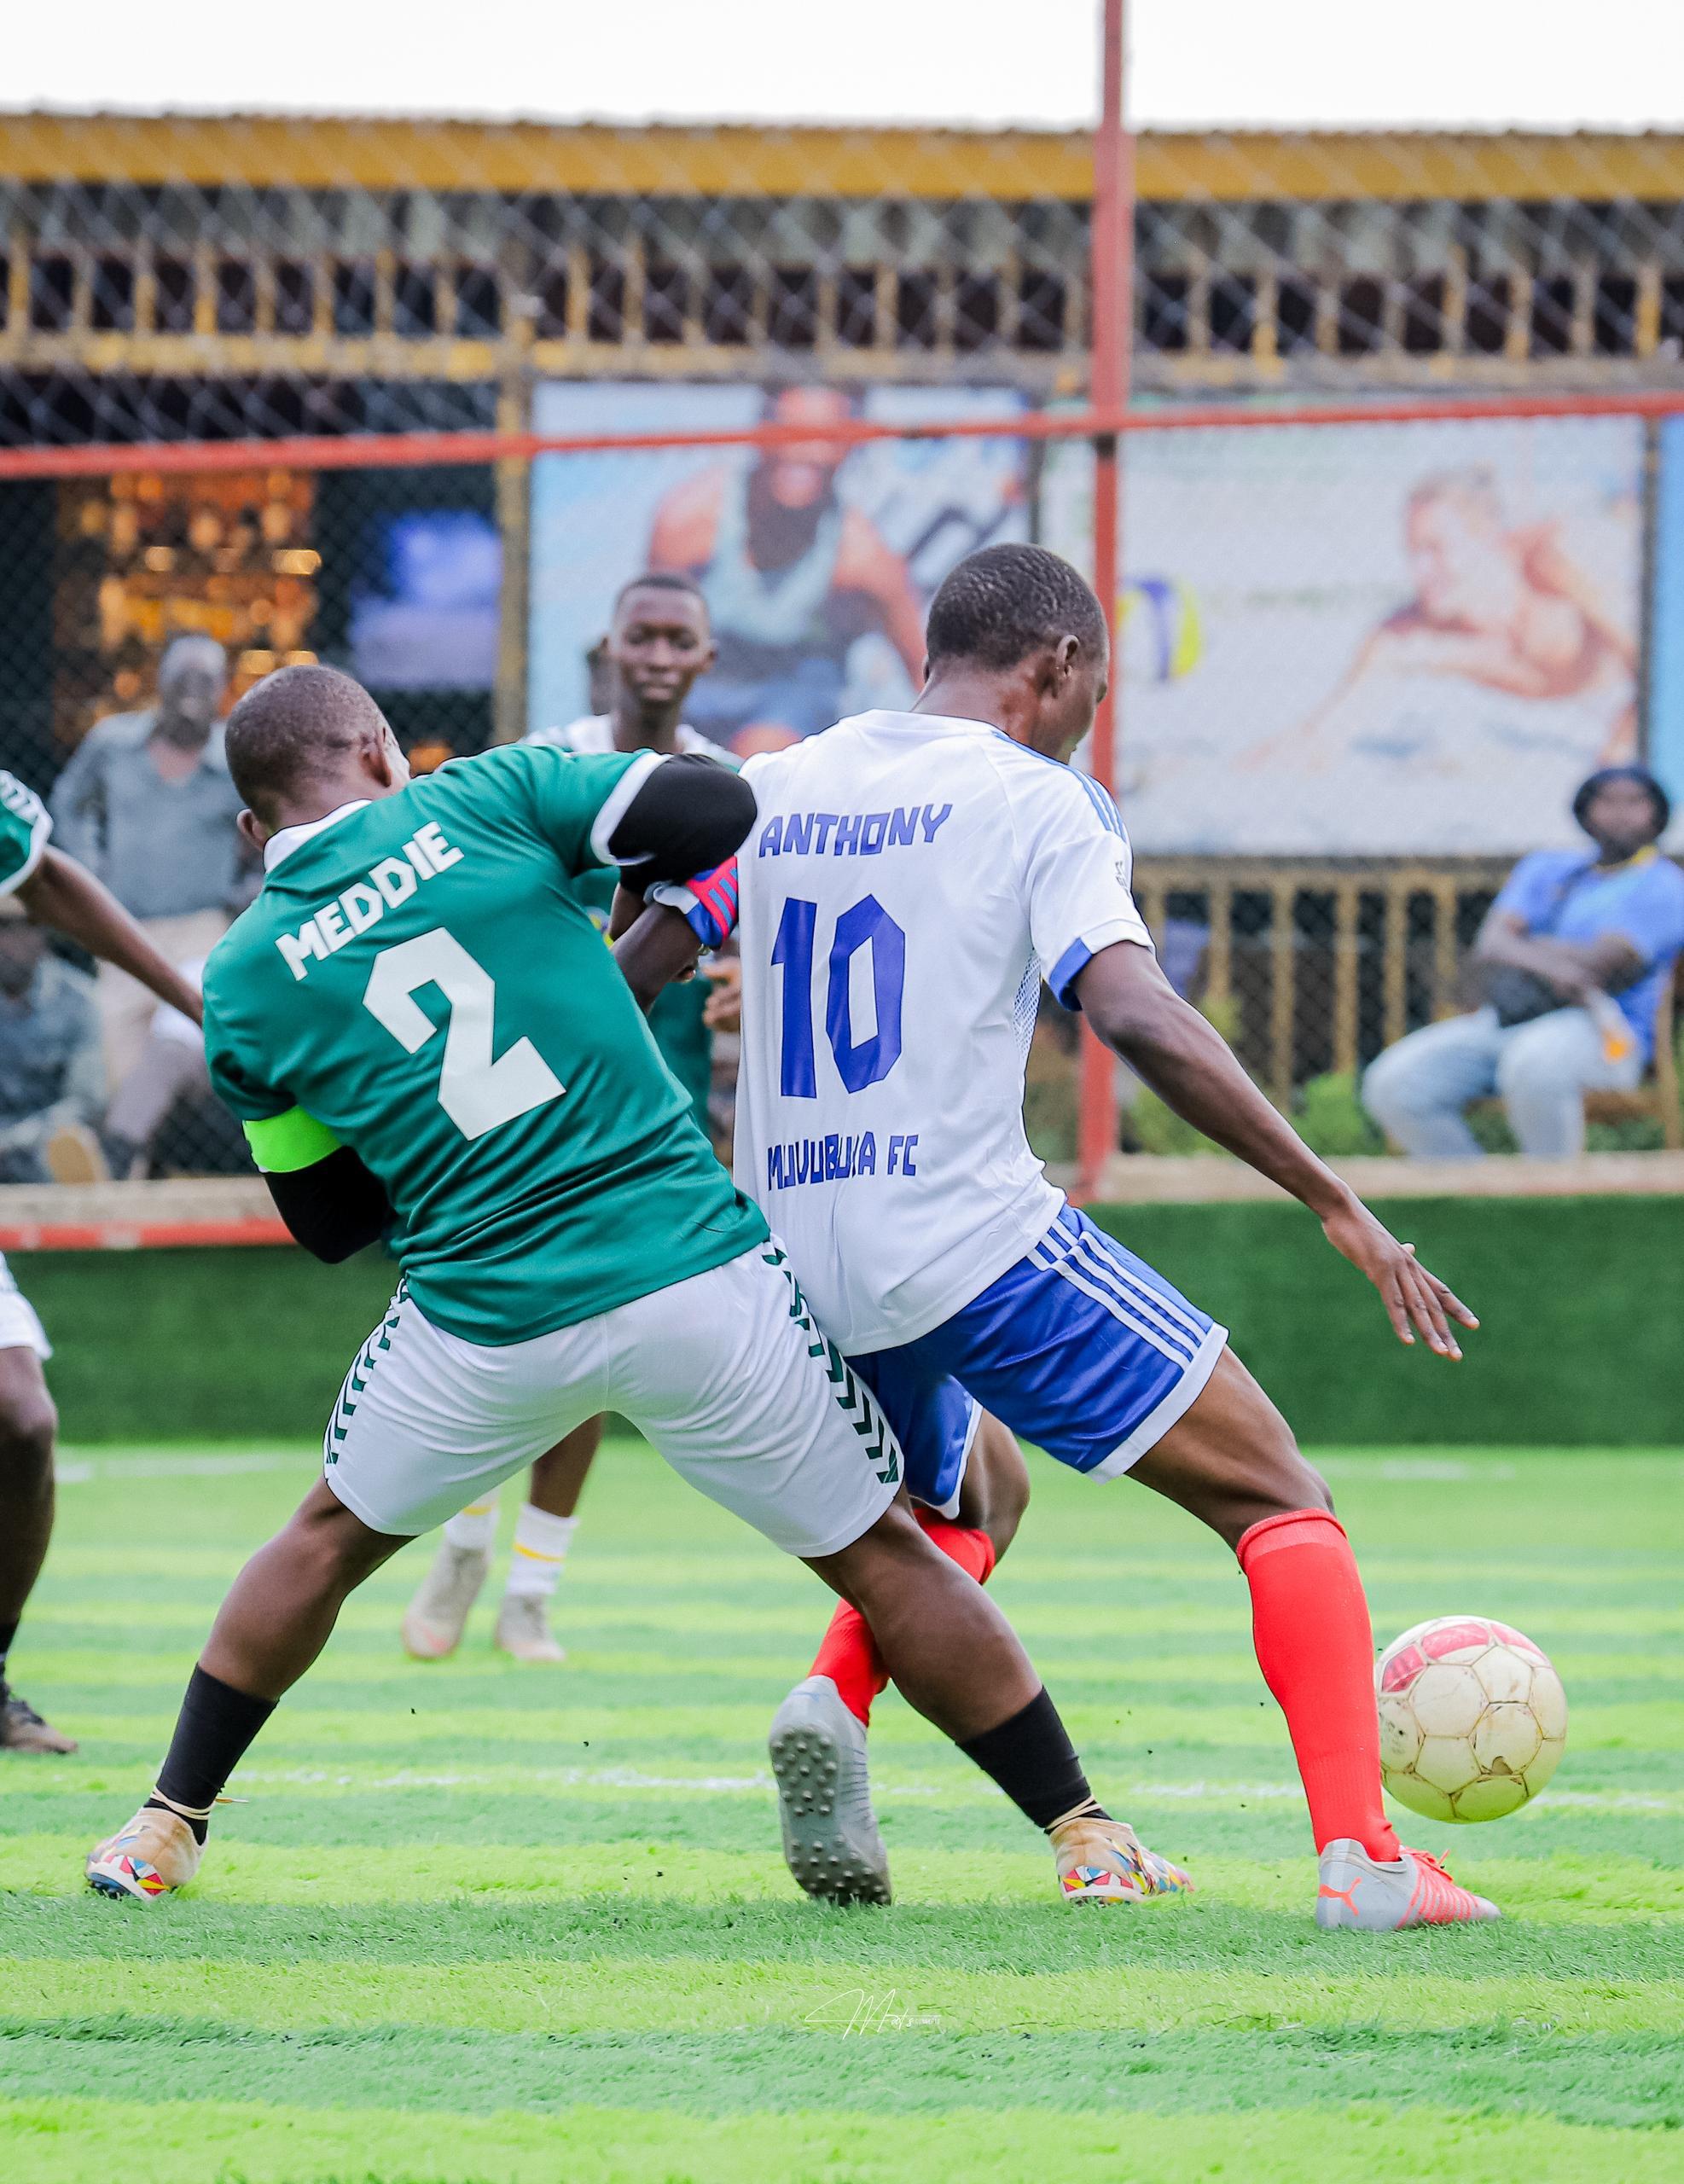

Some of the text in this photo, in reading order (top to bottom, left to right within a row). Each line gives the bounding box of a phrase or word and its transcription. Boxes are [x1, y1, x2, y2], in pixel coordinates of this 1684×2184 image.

[274, 821, 465, 981] MEDDIE
[758, 804, 953, 858] ANTHONY
[362, 926, 566, 1141] 2
[770, 893, 906, 1099] 10
[886, 1134, 920, 1176] FC
